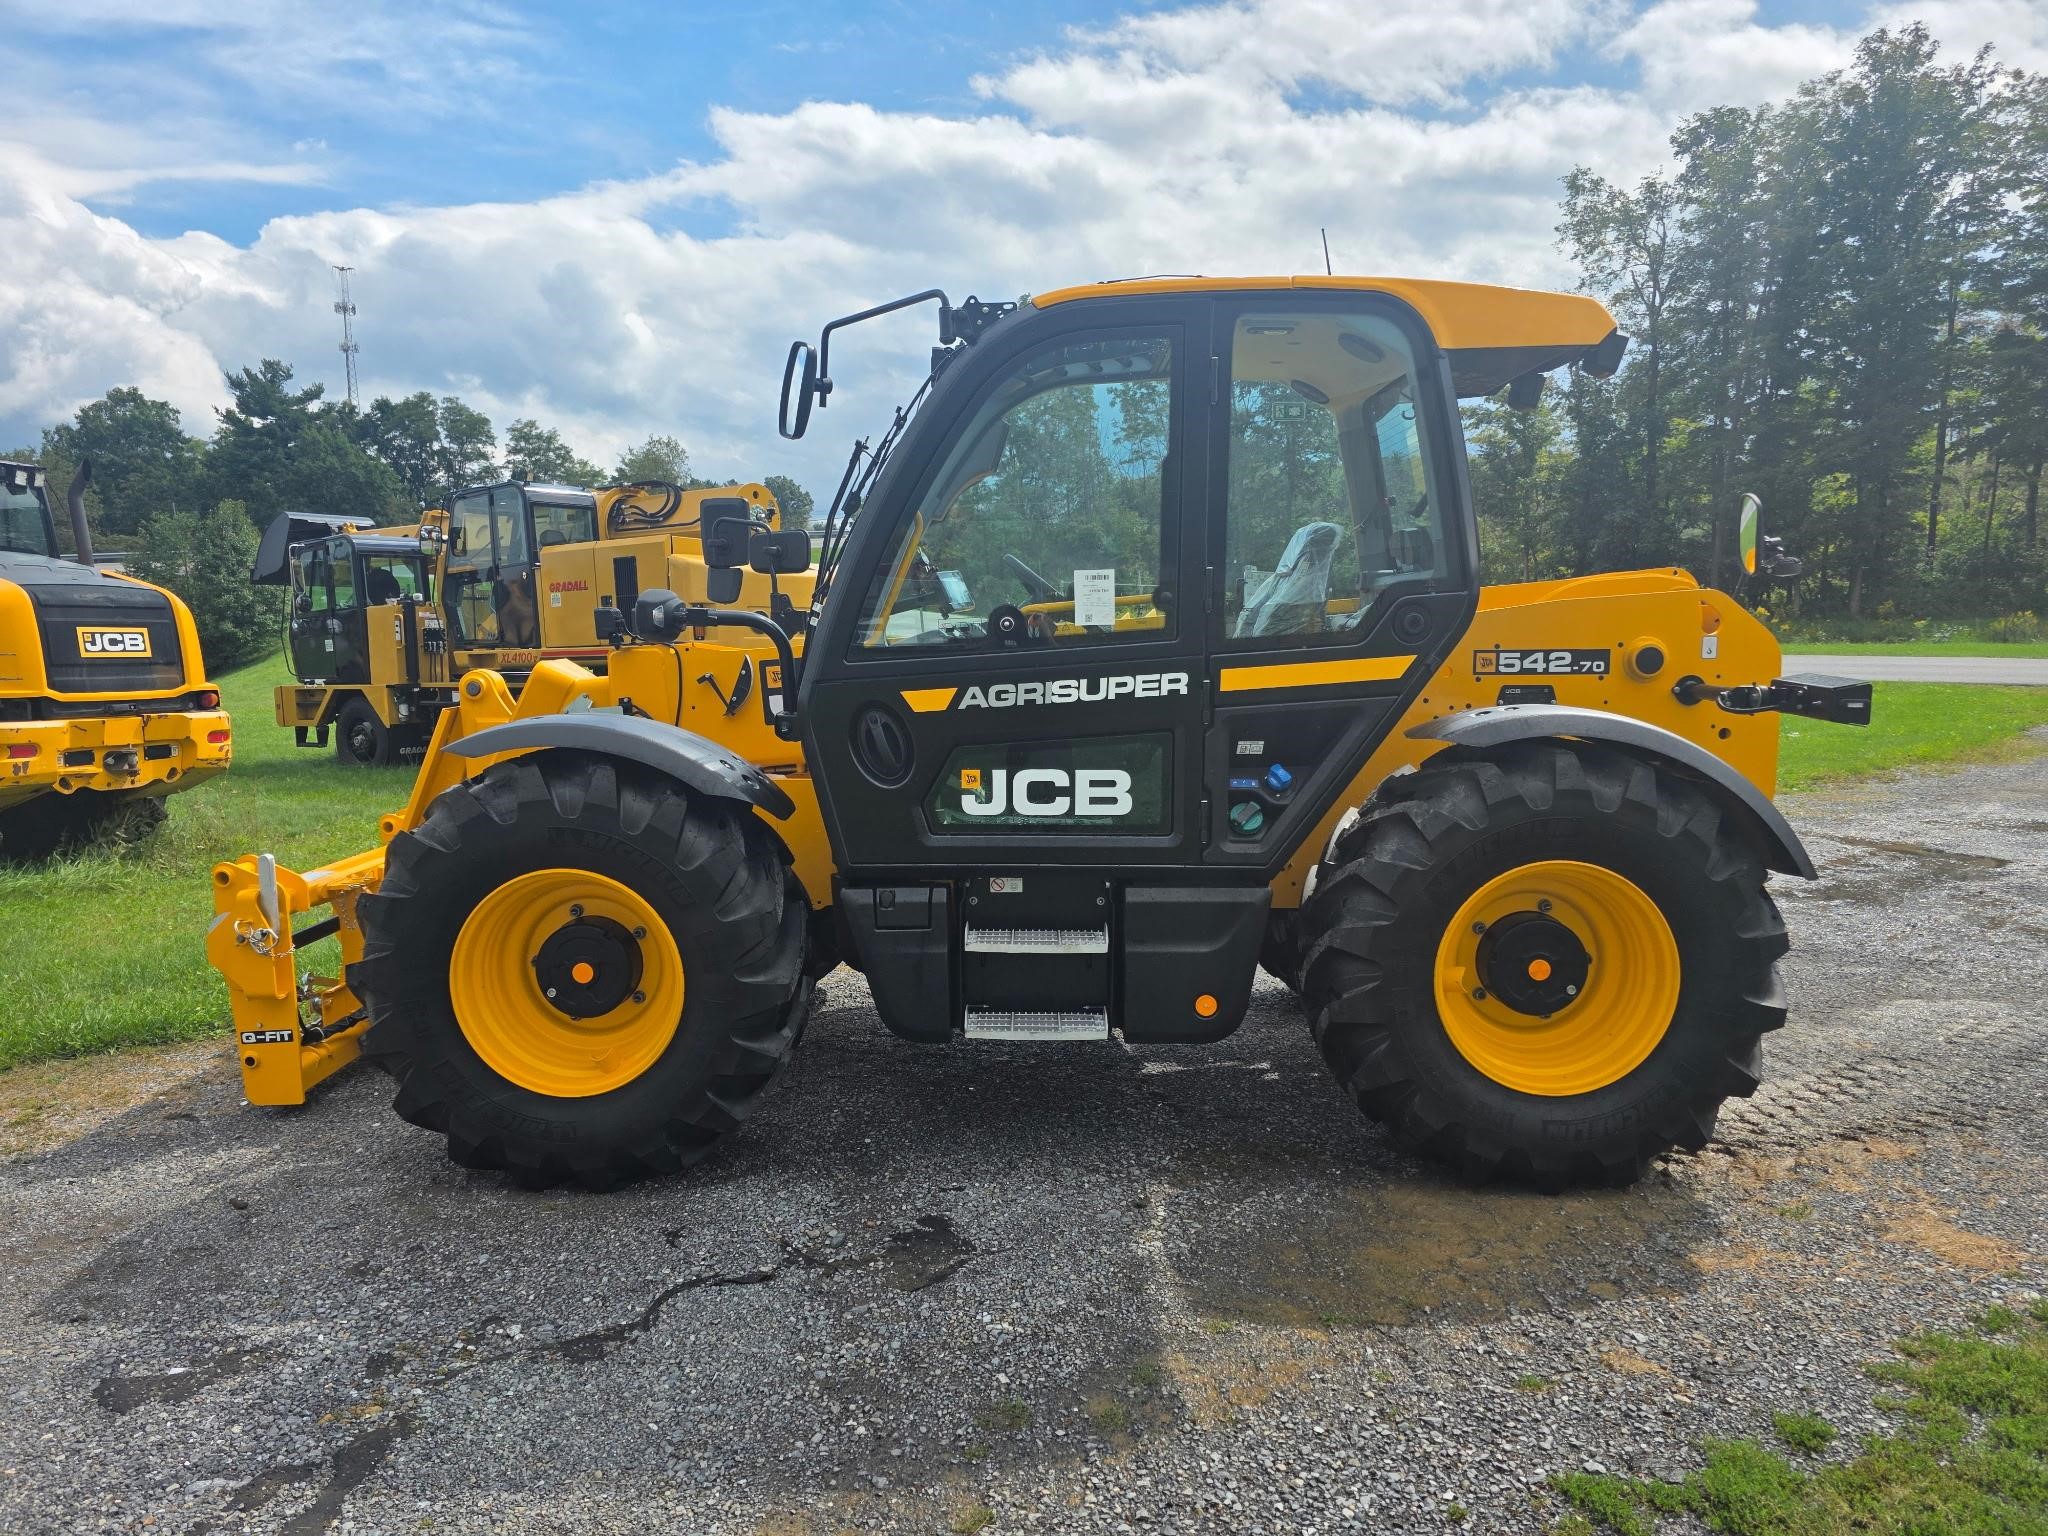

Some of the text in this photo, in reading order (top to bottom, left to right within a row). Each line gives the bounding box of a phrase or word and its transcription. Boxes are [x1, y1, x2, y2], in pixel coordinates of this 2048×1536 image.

[549, 580, 588, 592] GRADALL
[84, 633, 145, 652] JCB
[1498, 651, 1605, 673] 542-70
[399, 745, 427, 754] GRADA
[961, 769, 1133, 816] JCB
[241, 1030, 292, 1044] Q-FIT
